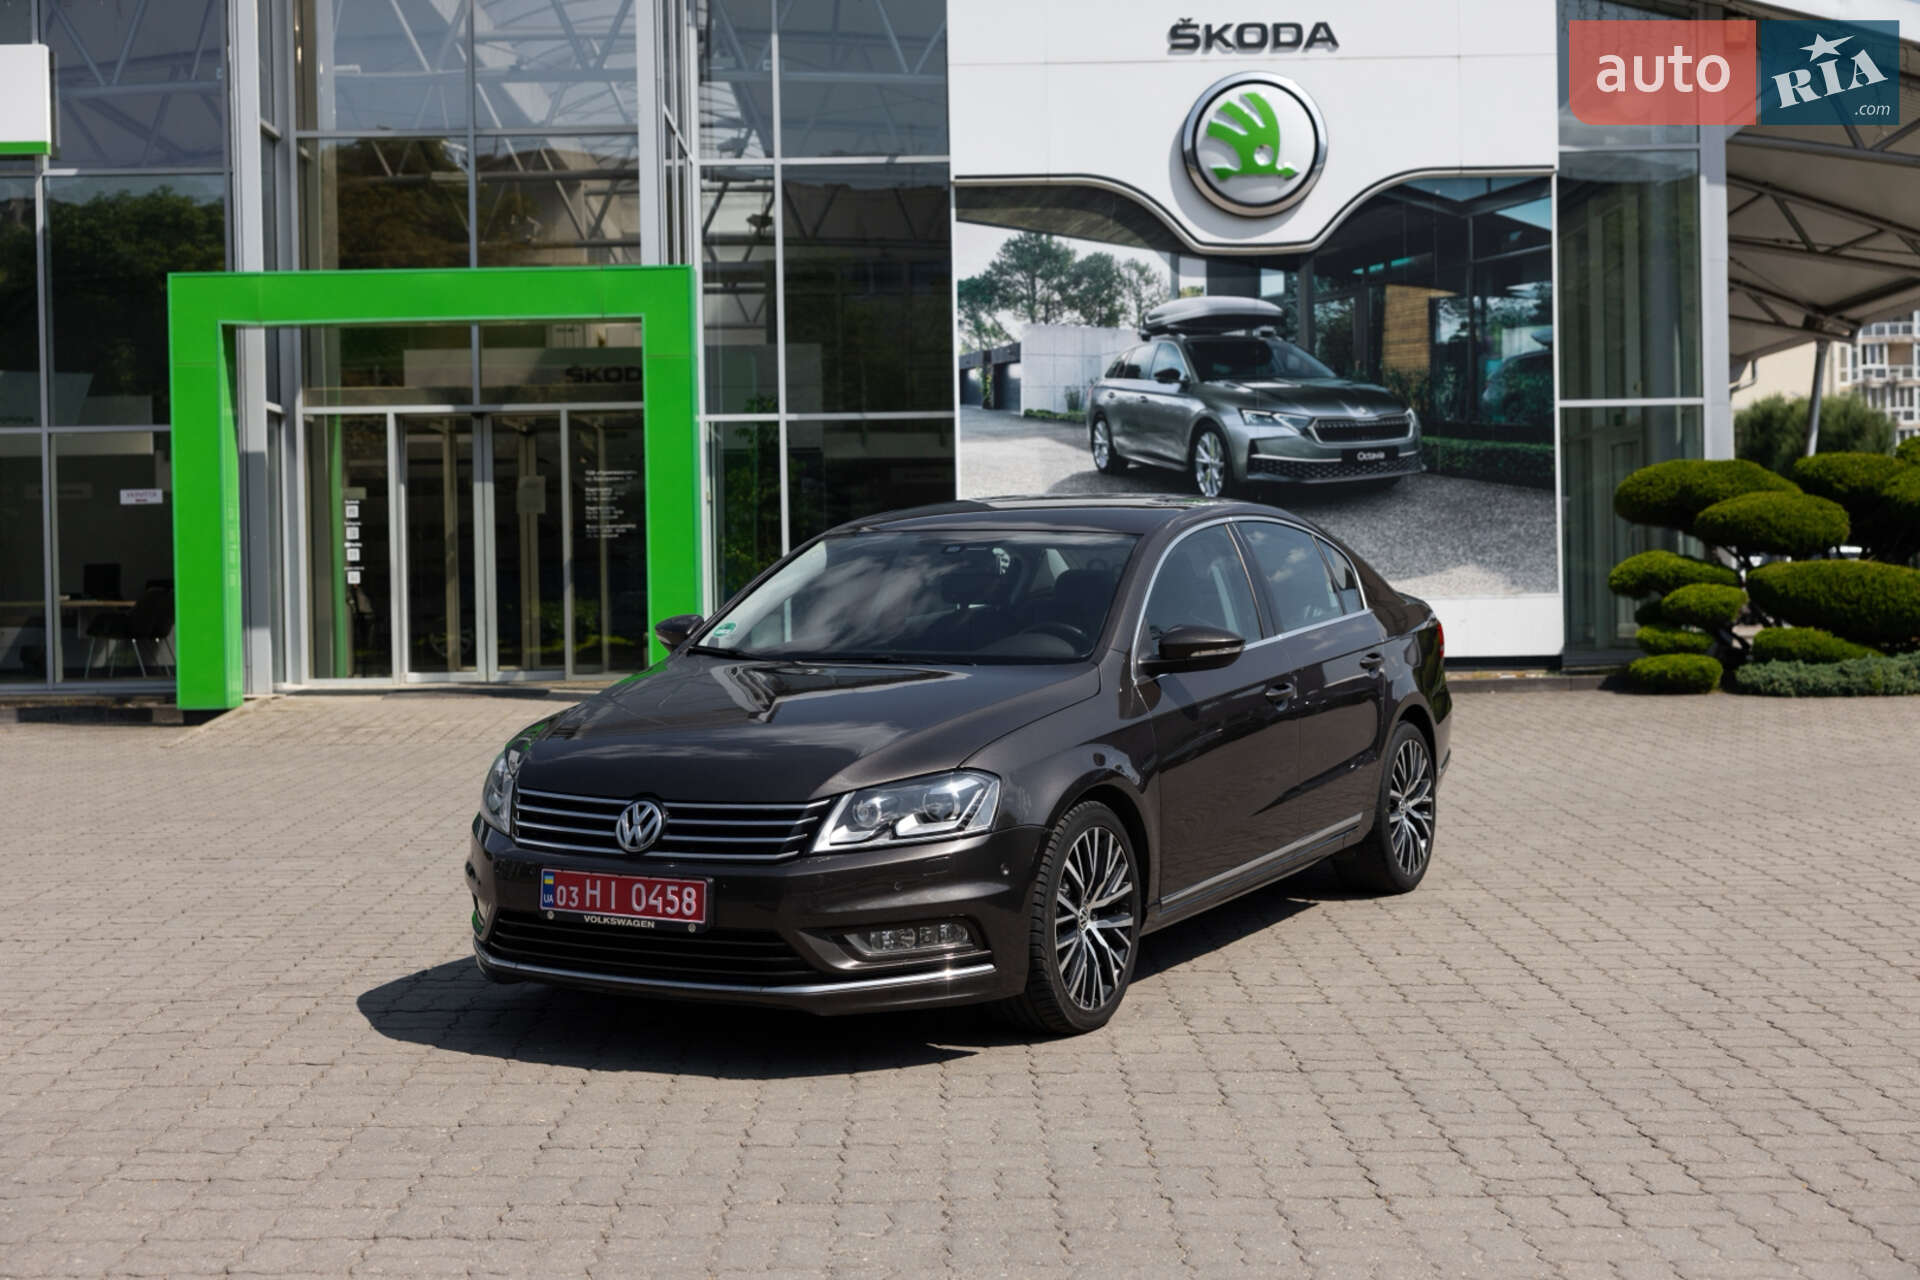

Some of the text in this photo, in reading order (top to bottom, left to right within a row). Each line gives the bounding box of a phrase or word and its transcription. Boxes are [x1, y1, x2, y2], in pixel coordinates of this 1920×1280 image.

[1168, 18, 1339, 53] ŠKODA
[566, 362, 641, 383] ŠKOD
[544, 893, 554, 904] UA
[556, 885, 579, 908] 03
[631, 882, 697, 916] 0458
[583, 914, 656, 929] VOLKSWAGEN
